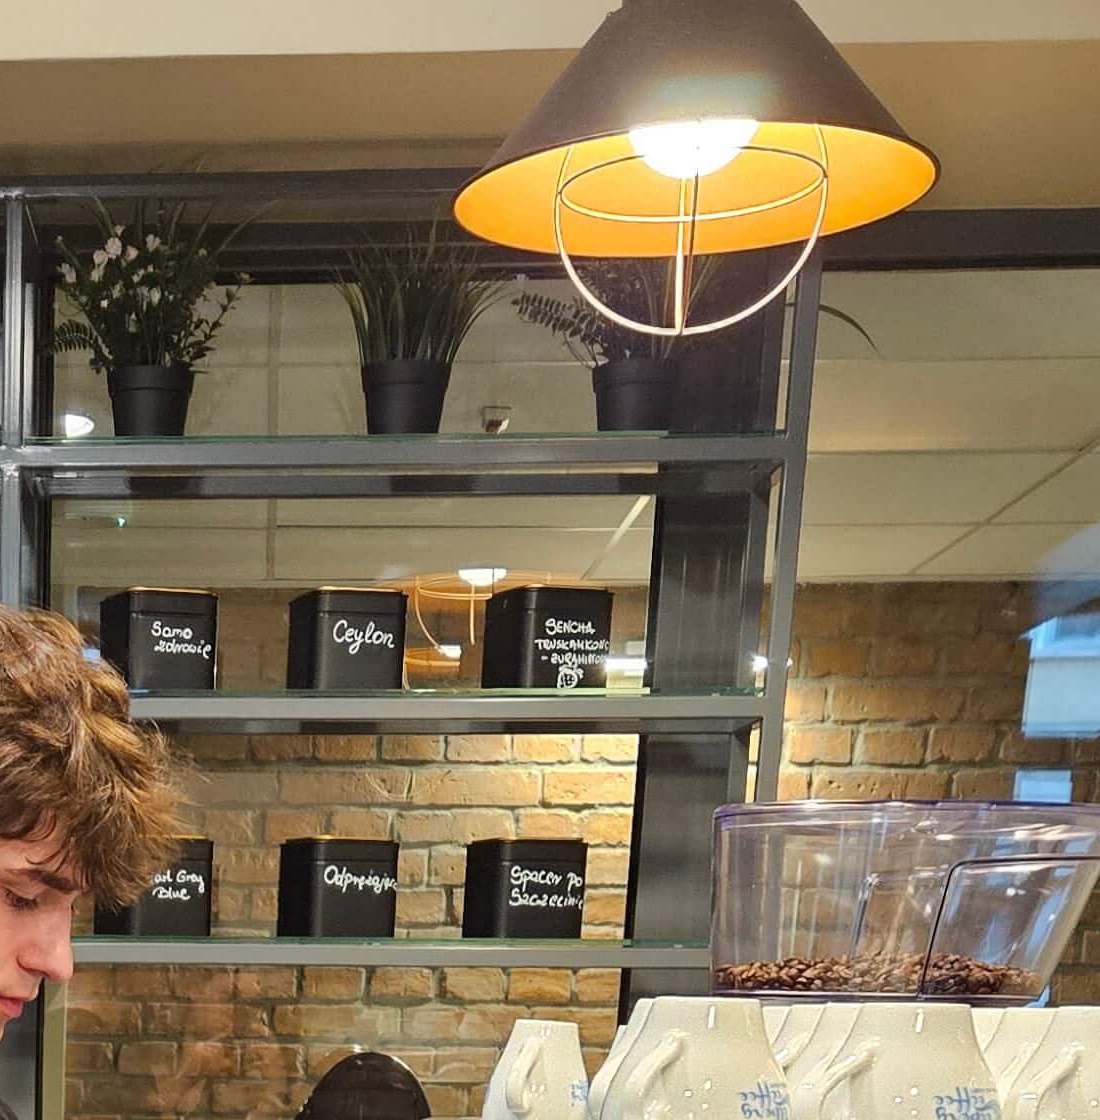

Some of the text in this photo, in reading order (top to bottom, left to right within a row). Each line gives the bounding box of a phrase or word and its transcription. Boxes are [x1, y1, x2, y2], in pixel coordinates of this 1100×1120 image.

[150, 620, 193, 639] Samo
[545, 618, 596, 635] SENCHA
[333, 619, 395, 655] Ceylon
[152, 869, 173, 884] arl
[510, 865, 562, 892] Spacer
[152, 886, 191, 900] Blue
